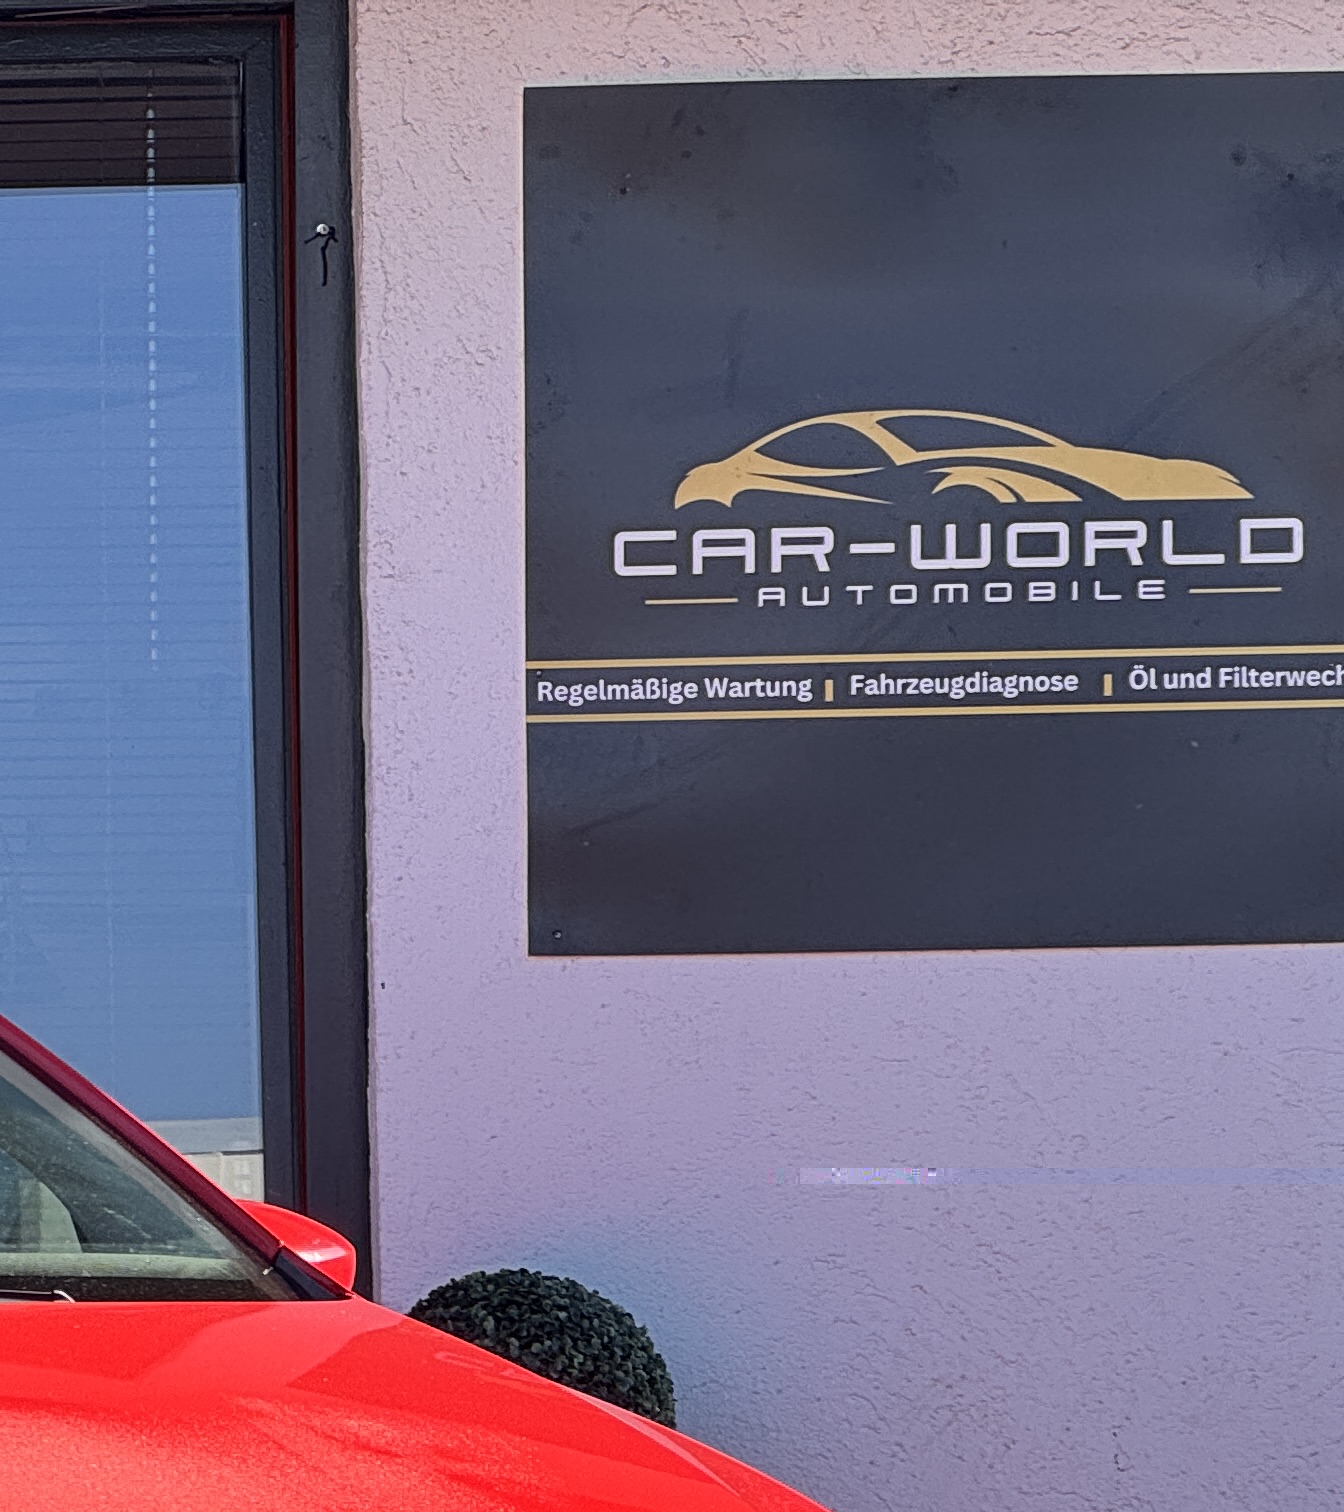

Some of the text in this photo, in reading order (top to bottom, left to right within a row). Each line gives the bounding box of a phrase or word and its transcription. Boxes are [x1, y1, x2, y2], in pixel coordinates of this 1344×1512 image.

[613, 517, 1304, 577] CAR-WORLD
[757, 579, 1166, 608] AUTOMOBILE
[537, 676, 699, 706] Regelmäßige
[703, 677, 813, 704] Wartung
[850, 671, 1080, 699] Fahrzeugdiagnose
[1128, 665, 1158, 690] Öl
[1163, 666, 1212, 690] und
